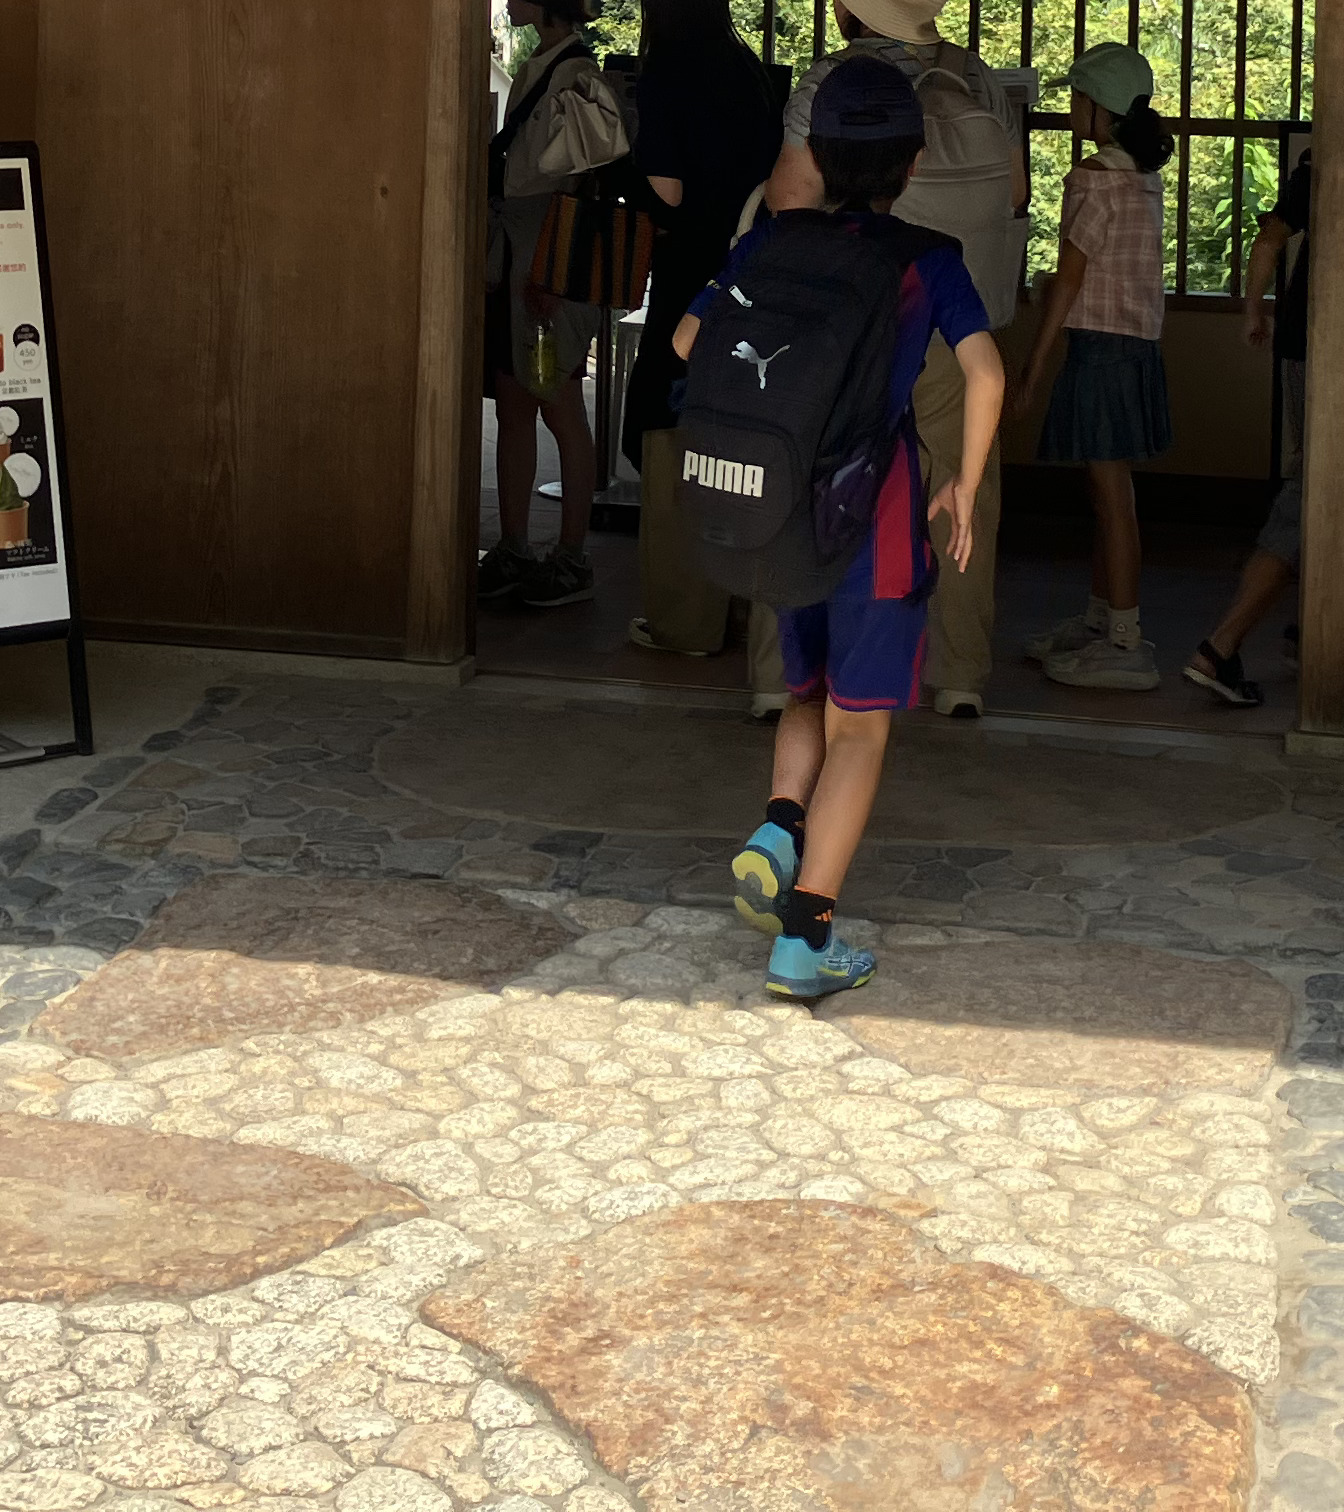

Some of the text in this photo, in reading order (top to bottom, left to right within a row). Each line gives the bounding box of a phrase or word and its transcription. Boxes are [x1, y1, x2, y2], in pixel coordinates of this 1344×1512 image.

[19, 348, 36, 357] 450
[9, 378, 28, 386] black
[682, 448, 764, 498] PUMA
